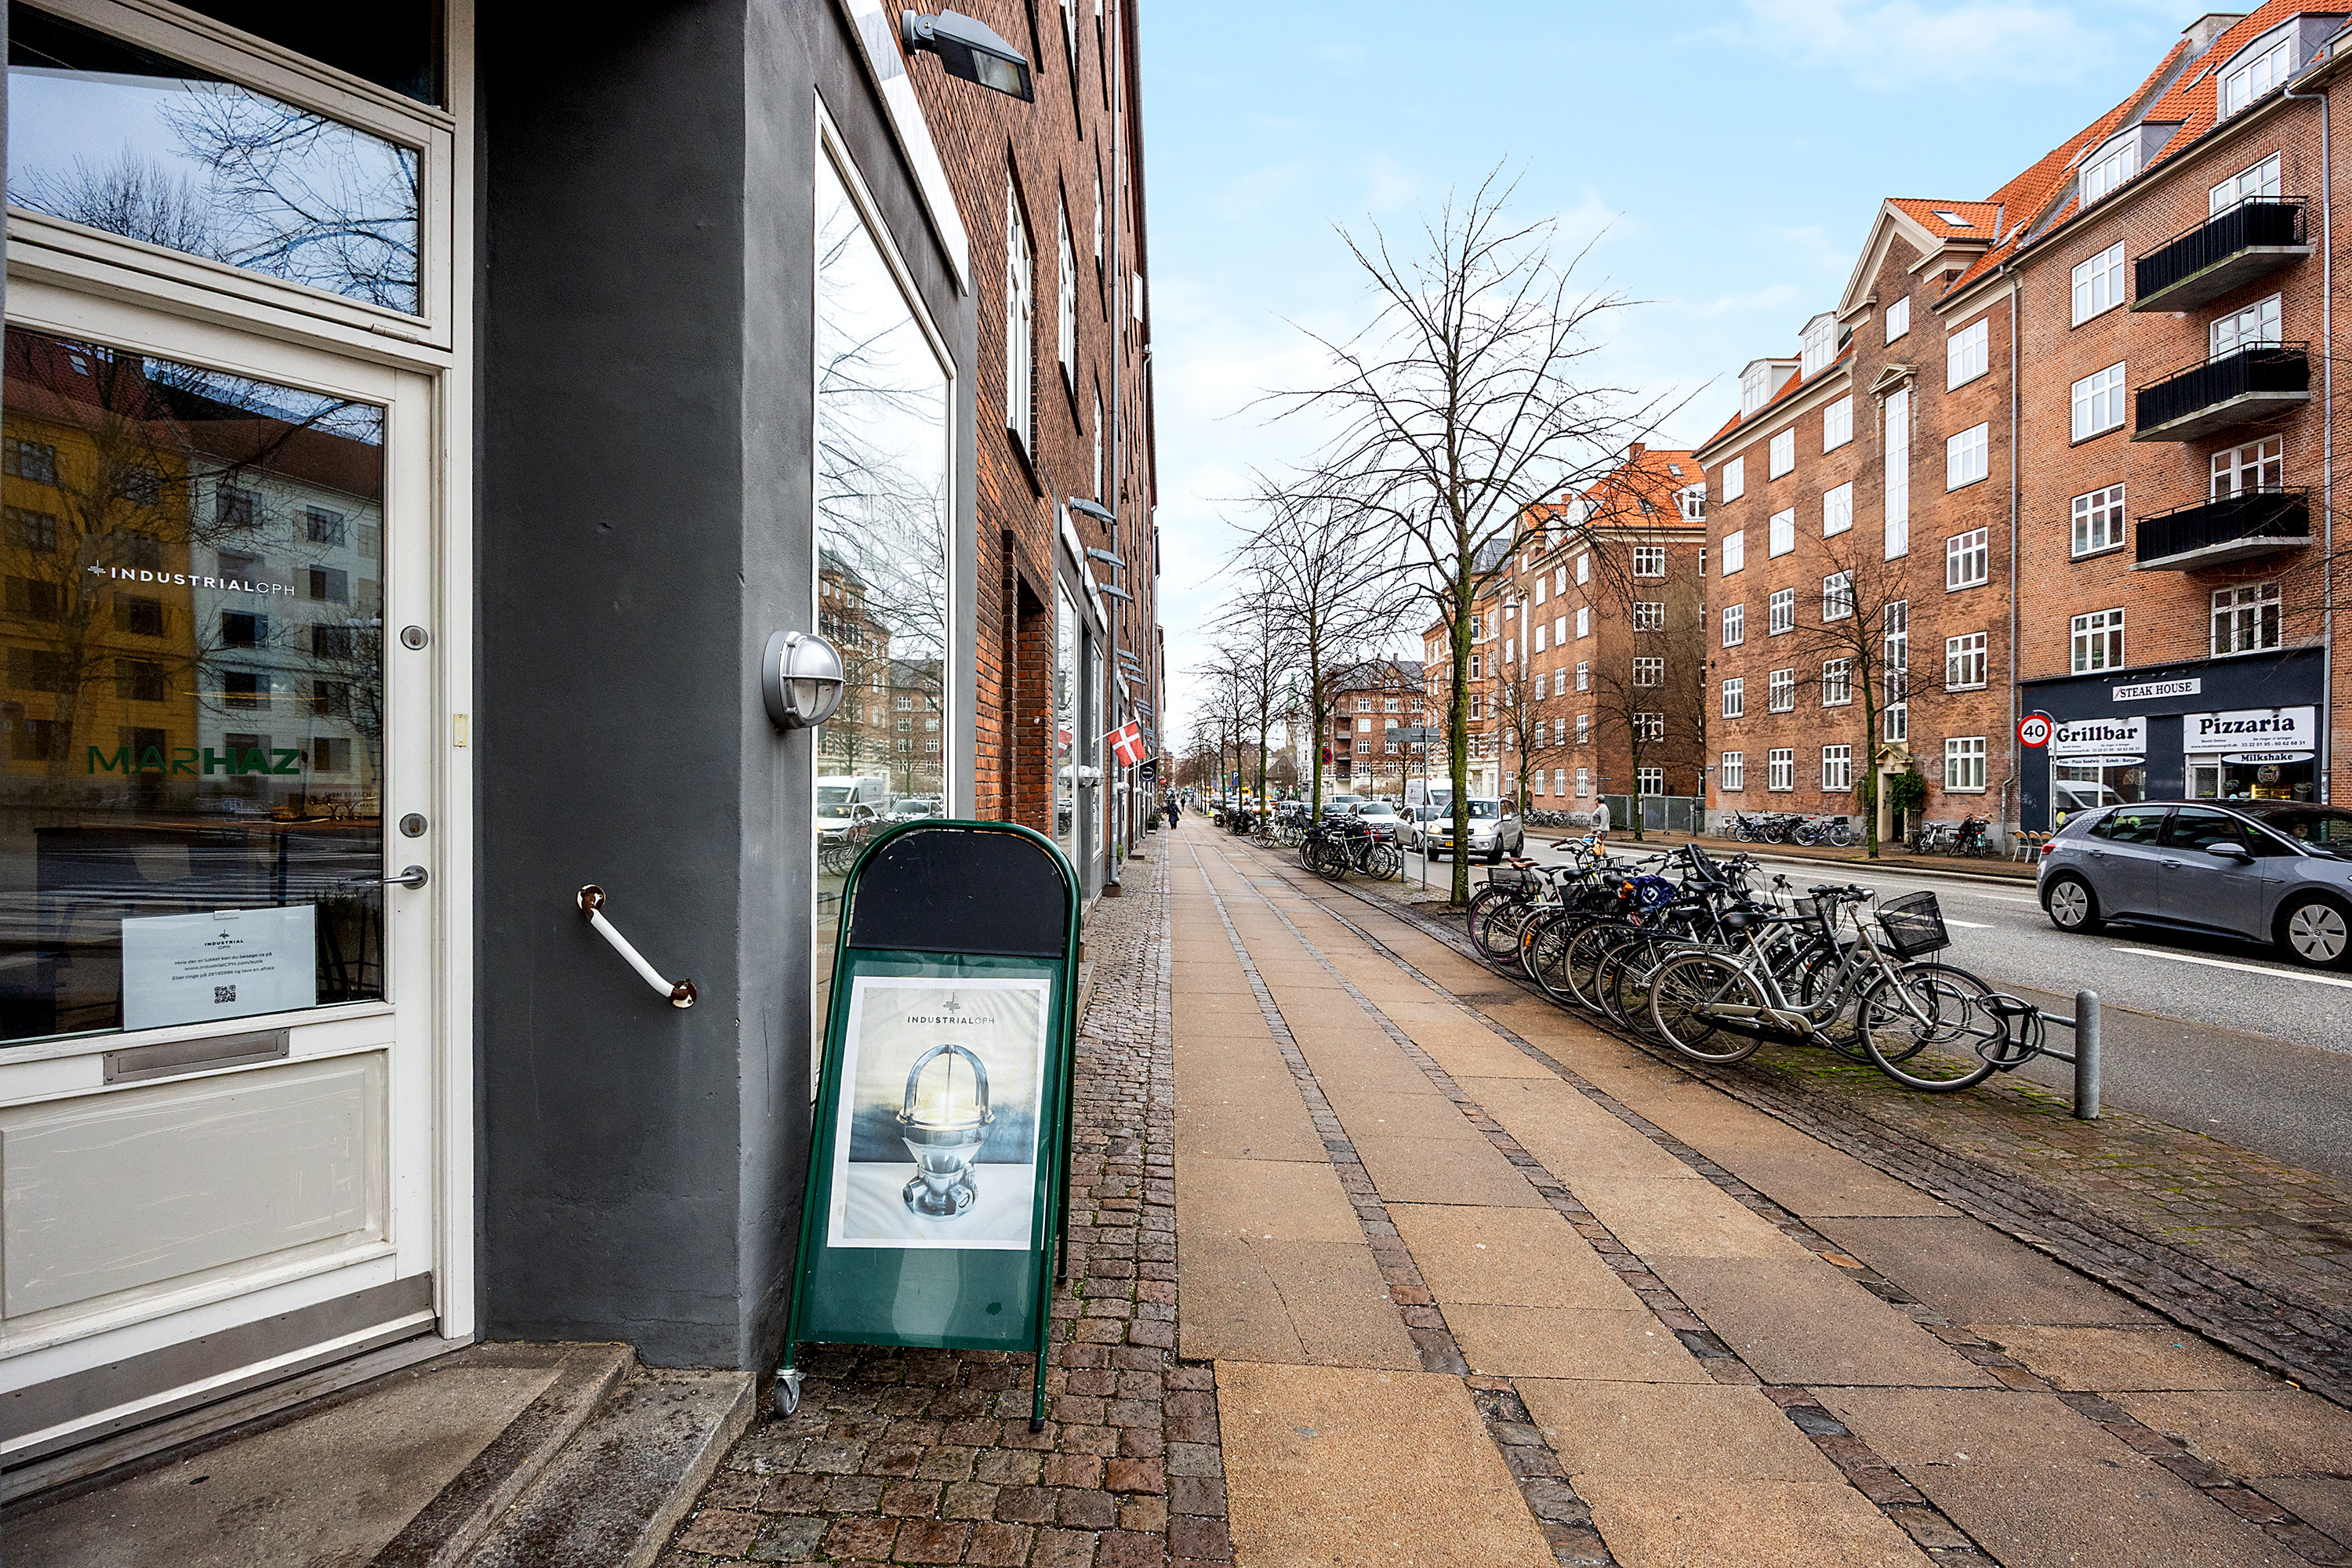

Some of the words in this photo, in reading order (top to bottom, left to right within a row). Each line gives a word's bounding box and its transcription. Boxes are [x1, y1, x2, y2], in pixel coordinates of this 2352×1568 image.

[2120, 686, 2153, 699] STEAK
[2156, 681, 2192, 695] HOUSE
[2024, 725, 2045, 738] 40
[2199, 713, 2296, 735] Pizzaria
[2056, 726, 2138, 742] Grillbar
[89, 746, 301, 775] MARHAZ
[2241, 753, 2293, 762] Milkshake
